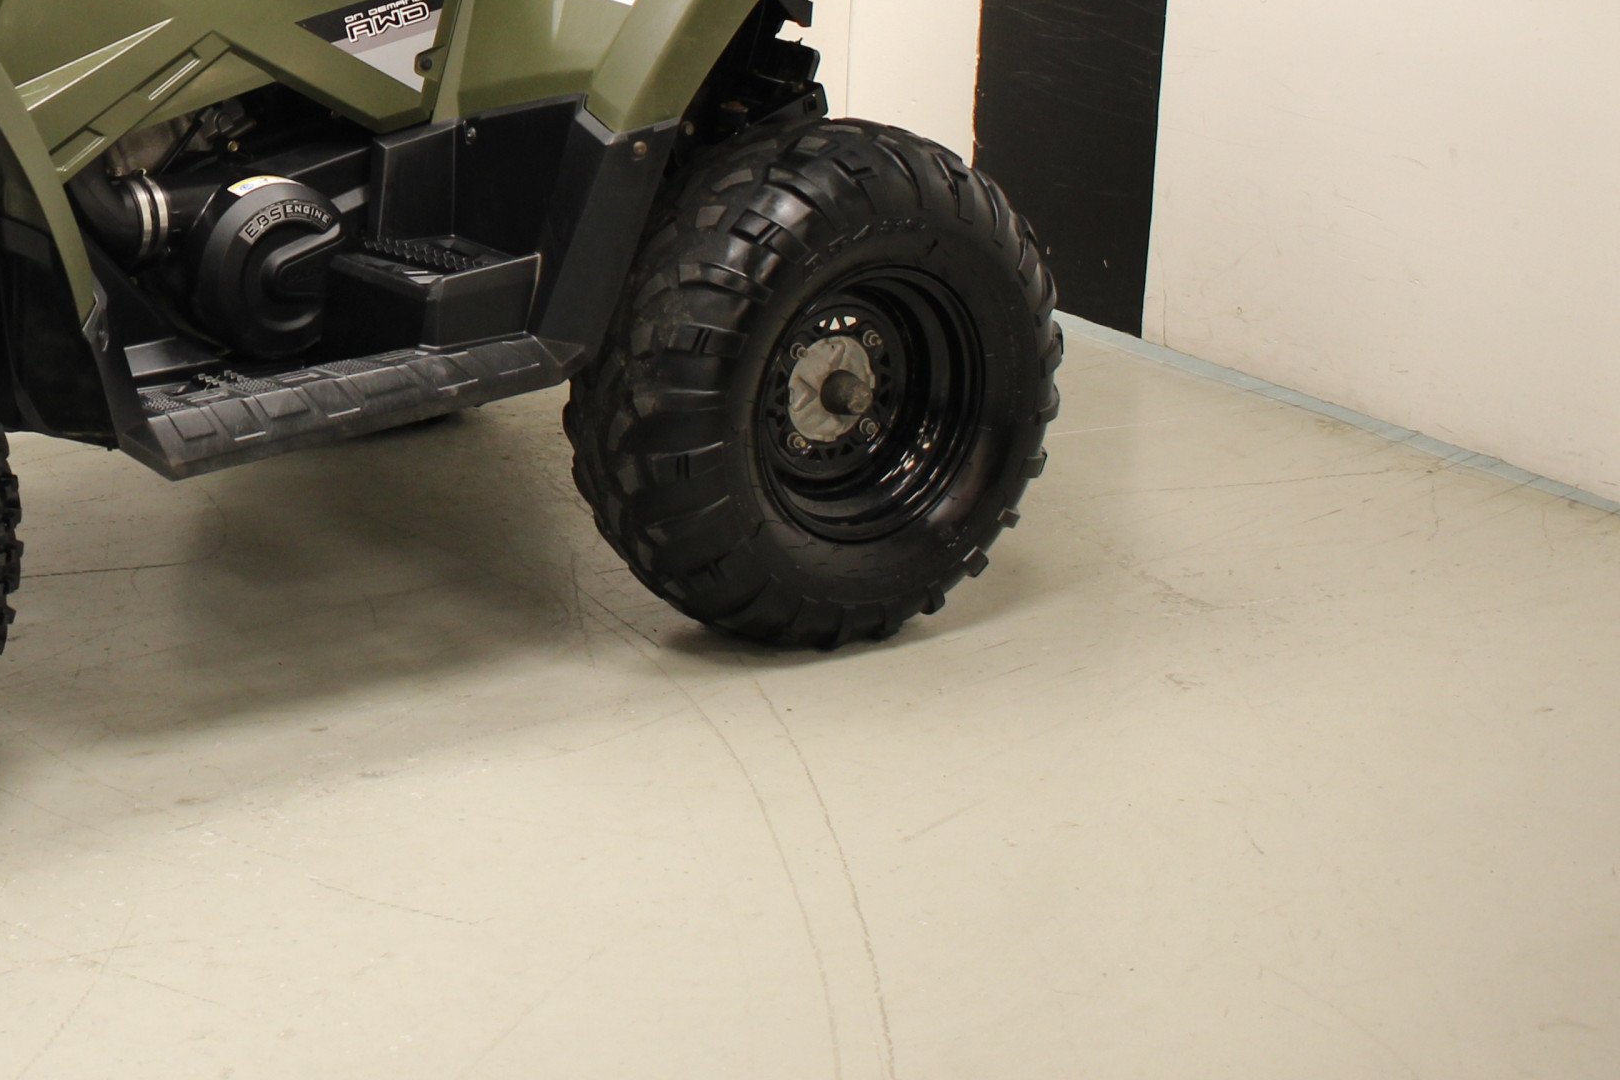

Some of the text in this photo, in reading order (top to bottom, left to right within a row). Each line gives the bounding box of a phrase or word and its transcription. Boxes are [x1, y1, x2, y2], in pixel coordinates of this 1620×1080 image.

[345, 1, 430, 43] AWD
[244, 207, 282, 239] EBS
[285, 204, 330, 224] ENGINE
